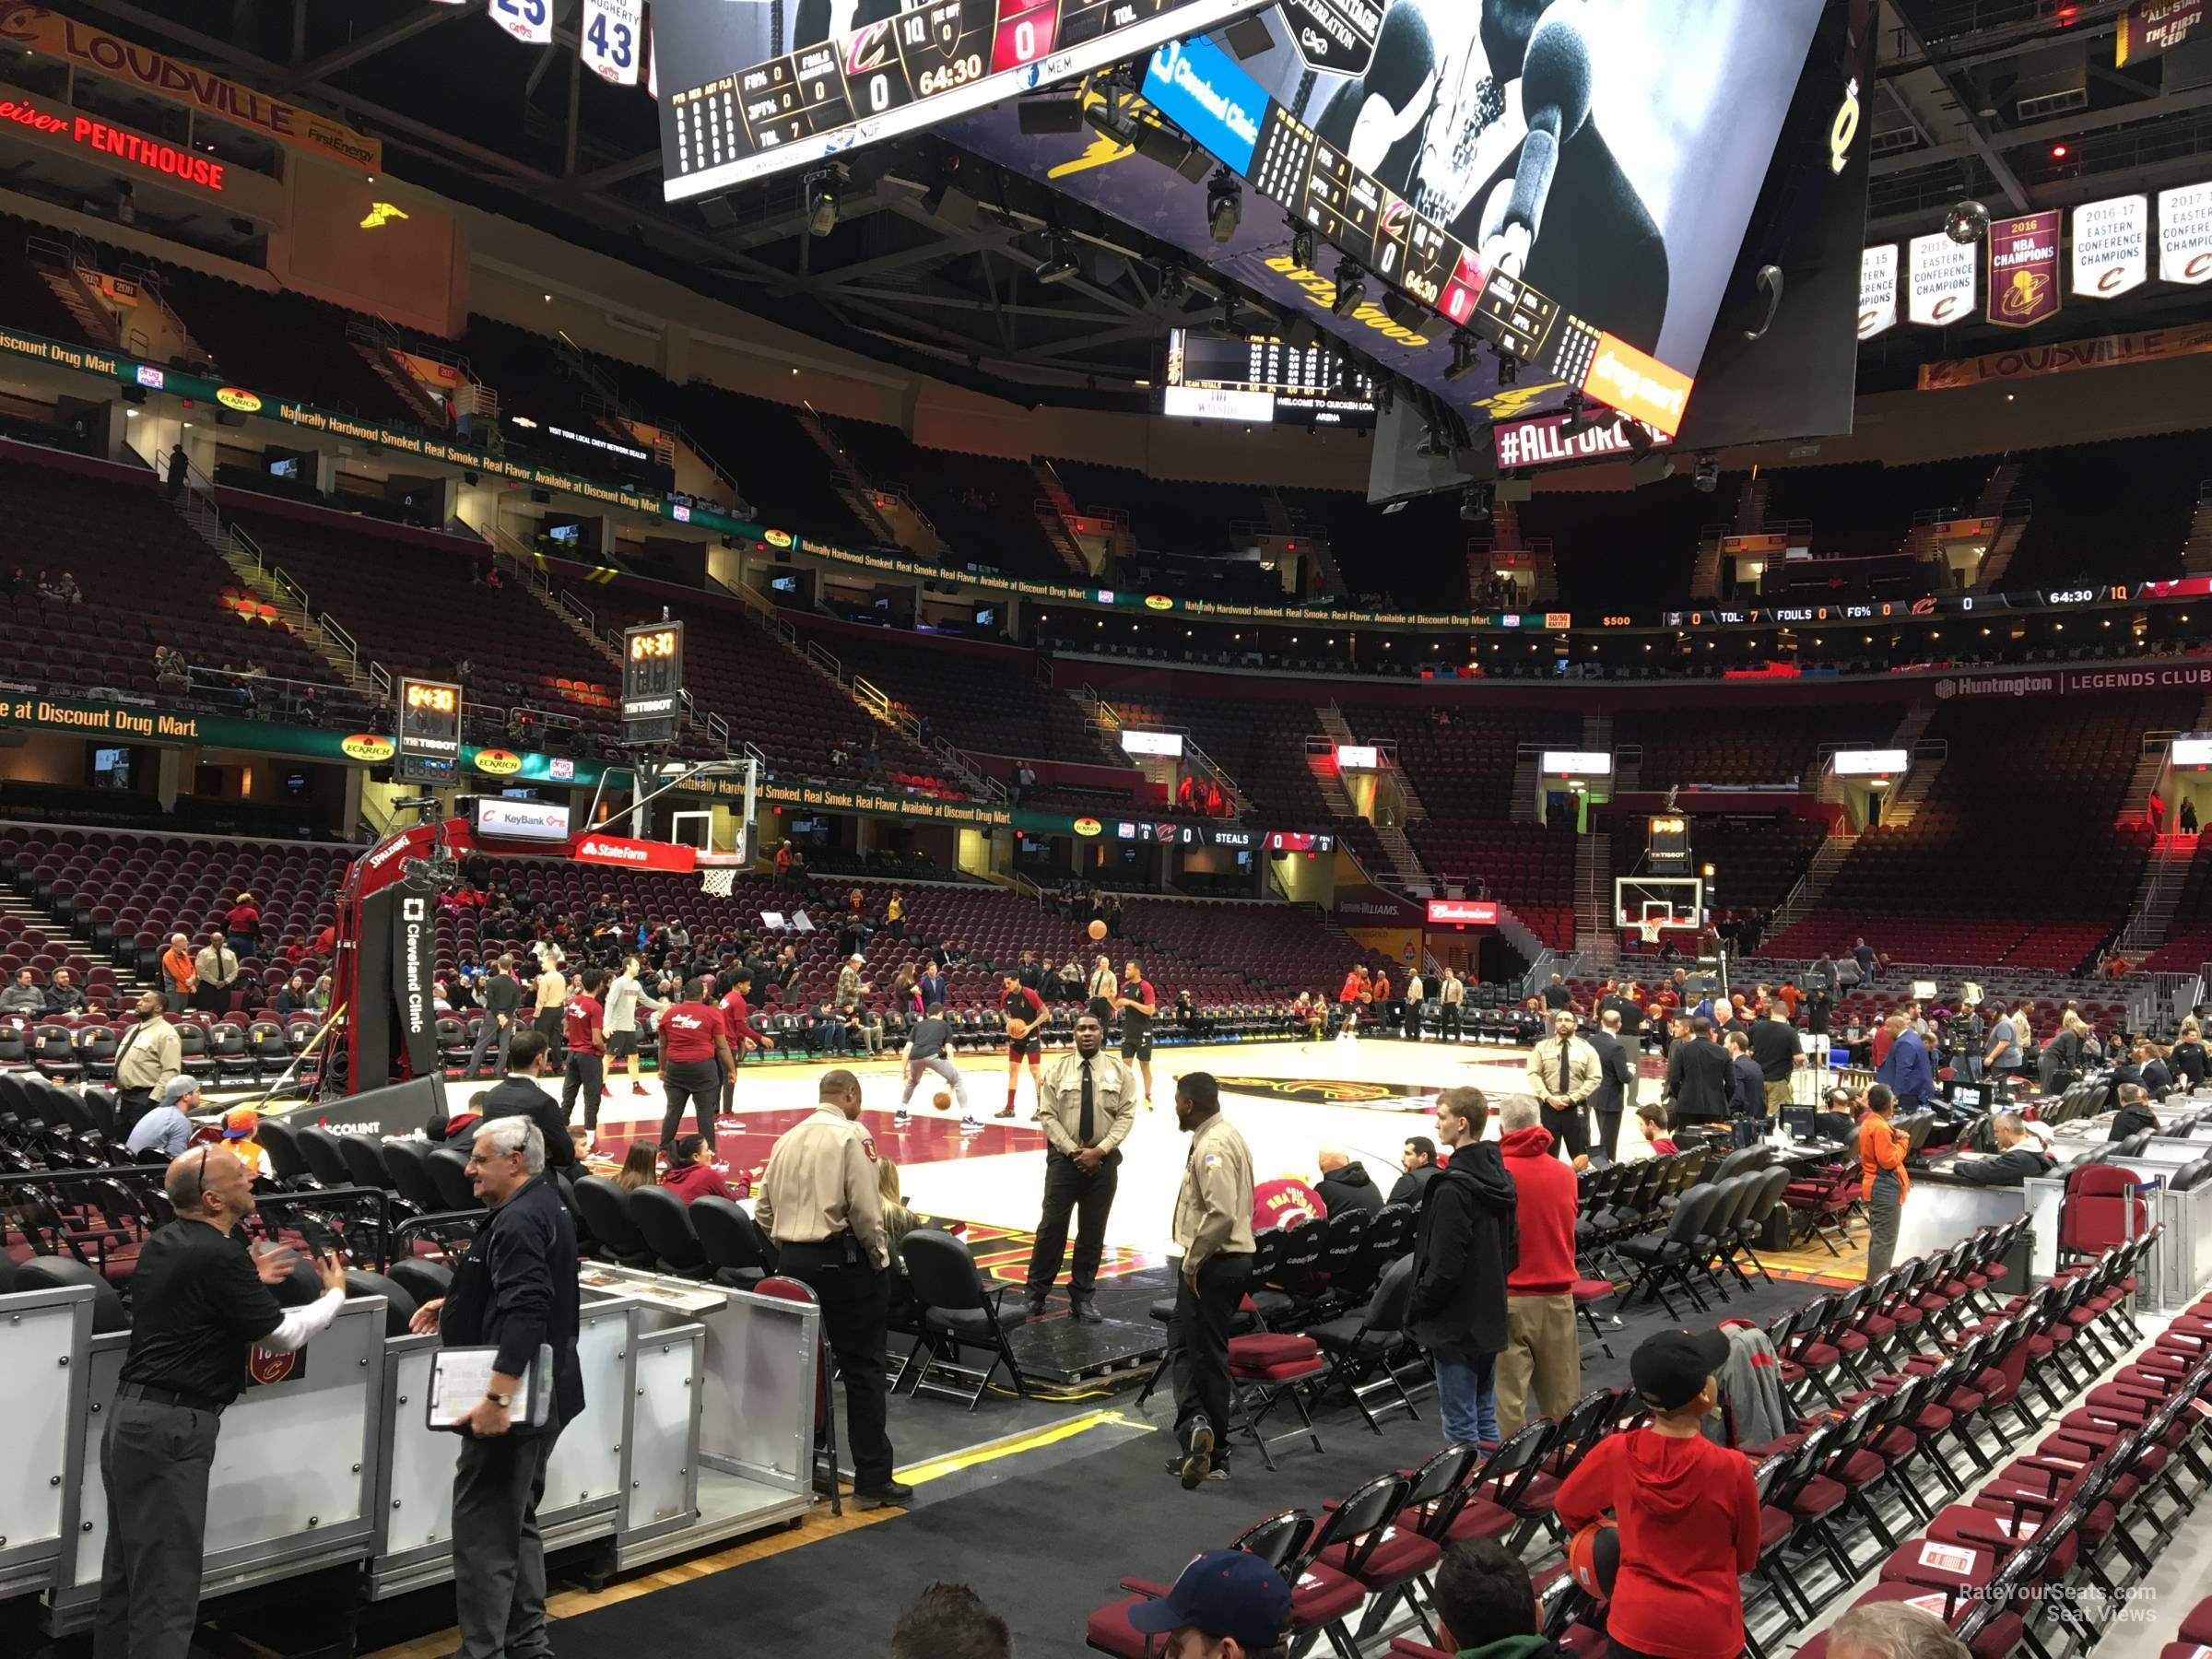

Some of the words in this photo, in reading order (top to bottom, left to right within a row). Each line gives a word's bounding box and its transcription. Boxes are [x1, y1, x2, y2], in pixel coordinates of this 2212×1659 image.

[904, 16, 925, 45] 1Q
[942, 24, 952, 41] 0
[2146, 26, 2167, 43] THE
[2171, 11, 2202, 34] FIRST
[587, 12, 632, 68] 43
[1015, 20, 1035, 61] 0
[2160, 29, 2187, 48] CEDI
[774, 65, 782, 81] 0
[920, 54, 982, 95] 64:30
[1047, 55, 1072, 76] MEM
[65, 20, 295, 136] LOUDVILLE
[815, 81, 825, 100] 0
[870, 74, 889, 112] 0
[782, 93, 791, 108] 0
[791, 122, 799, 138] 7
[74, 117, 224, 190] PENTHOUSE
[308, 127, 374, 162] FirstEnergy
[2011, 219, 2037, 233] 2016
[2087, 220, 2133, 238] EASTERN
[2013, 239, 2035, 252] NBA
[2078, 232, 2143, 253] CONFERENCE
[1382, 242, 1396, 273] 0
[1923, 253, 1964, 269] EASTERN
[1994, 245, 2054, 266] CHAMPIONS
[2081, 247, 2139, 265] CHAMPIONS
[1864, 269, 1885, 280] TERN
[1914, 264, 1973, 283] CONFERENCE
[1405, 270, 1438, 303] 64:30
[1860, 279, 1893, 293] ERENCE
[1916, 277, 1971, 295] CHAMPIONS
[1449, 288, 1465, 316] 0
[52, 345, 81, 369] Drug
[85, 353, 118, 376] Mart.
[1978, 332, 2166, 380] LOUDVILLE
[139, 368, 160, 380] drug
[140, 378, 162, 387] mart
[1184, 380, 1199, 388] TEAM
[1201, 381, 1221, 389] TOTALS
[220, 394, 258, 409] ECKRICH
[1277, 397, 1314, 407] WELCOME
[1316, 400, 1325, 408] TO
[1327, 400, 1359, 411] QUICKEN
[1316, 412, 1340, 422] ARENA
[548, 426, 562, 436] VISIT
[562, 429, 575, 441] YOUR
[575, 434, 591, 444] LOCAL
[591, 439, 606, 449] CHEVY
[606, 442, 629, 455] NETWORK
[629, 449, 647, 460] DEALER
[280, 404, 326, 430] Naturally
[329, 417, 378, 441] Hardwood
[381, 430, 421, 453] Smoked.
[425, 441, 445, 459] Real
[448, 448, 480, 466] Smoke.
[483, 456, 502, 473] Real
[505, 463, 533, 481] Flavor.
[535, 470, 571, 492] Available
[573, 482, 582, 494] at
[584, 484, 618, 503] Discount
[620, 492, 640, 510] Drug
[641, 497, 662, 514] Mart.
[802, 539, 830, 559] Naturally
[832, 547, 864, 565] Hardwood
[865, 555, 894, 570] Smoked.
[896, 560, 912, 574] Real
[914, 563, 938, 577] Smoke.
[940, 568, 956, 581] Real
[980, 574, 1009, 590] Available
[1010, 580, 1018, 591] at
[1018, 582, 1048, 596] Discount
[1049, 585, 1066, 599] Drug
[1184, 600, 1216, 615] Naturally
[1217, 604, 1252, 617] Hardwood
[1253, 606, 1284, 618] Smoked.
[1286, 607, 1302, 618] Real
[1304, 608, 1330, 620] Smoke.
[1332, 610, 1347, 621] Real
[1374, 613, 1406, 624] Available
[1407, 615, 1416, 624] at
[1418, 614, 1450, 625] Discount
[1451, 615, 1469, 627] Drug
[1692, 613, 1700, 625] 0
[1721, 612, 1744, 623] TOL:
[1750, 610, 1759, 623] 7
[1777, 609, 1812, 621] FOULS
[1818, 608, 1827, 620] 0
[1847, 606, 1871, 618] FG%
[1882, 604, 1890, 616] 0
[2050, 590, 2093, 604] 64:30
[2111, 585, 2127, 600] 1Q
[1548, 614, 1568, 622] 50/50
[1603, 616, 1630, 627] $500
[1959, 676, 2052, 696] Huntington
[2072, 670, 2155, 689] LEGENDS
[2161, 668, 2212, 686] CLUB
[638, 699, 673, 712] TISSOT
[15, 700, 33, 720] at
[38, 701, 110, 728] Discount
[115, 711, 152, 736] Drug
[159, 715, 199, 737] Mart.
[347, 744, 391, 757] ECKRICH
[418, 738, 458, 751] TISSOT
[478, 759, 518, 771] ECKRICH
[552, 760, 571, 771] drug
[553, 770, 573, 778] mart
[719, 780, 762, 797] Hardwd
[766, 785, 801, 802] Smoked.
[805, 789, 823, 805] Real
[824, 791, 853, 808] Smoke.
[856, 795, 874, 809] Real
[876, 797, 900, 812] Flavor.
[901, 799, 934, 817] Available
[935, 805, 942, 817] at
[945, 805, 974, 821] Discount
[975, 808, 992, 825] Drug
[994, 811, 1012, 825] Mart.
[505, 813, 545, 826] KeyBank
[1182, 829, 1192, 842] 0
[1216, 833, 1249, 844] STEALS
[1274, 835, 1282, 848] 0
[370, 834, 412, 868] SPALDING
[406, 924, 424, 993] Cleveland
[409, 994, 424, 1033] Clinic
